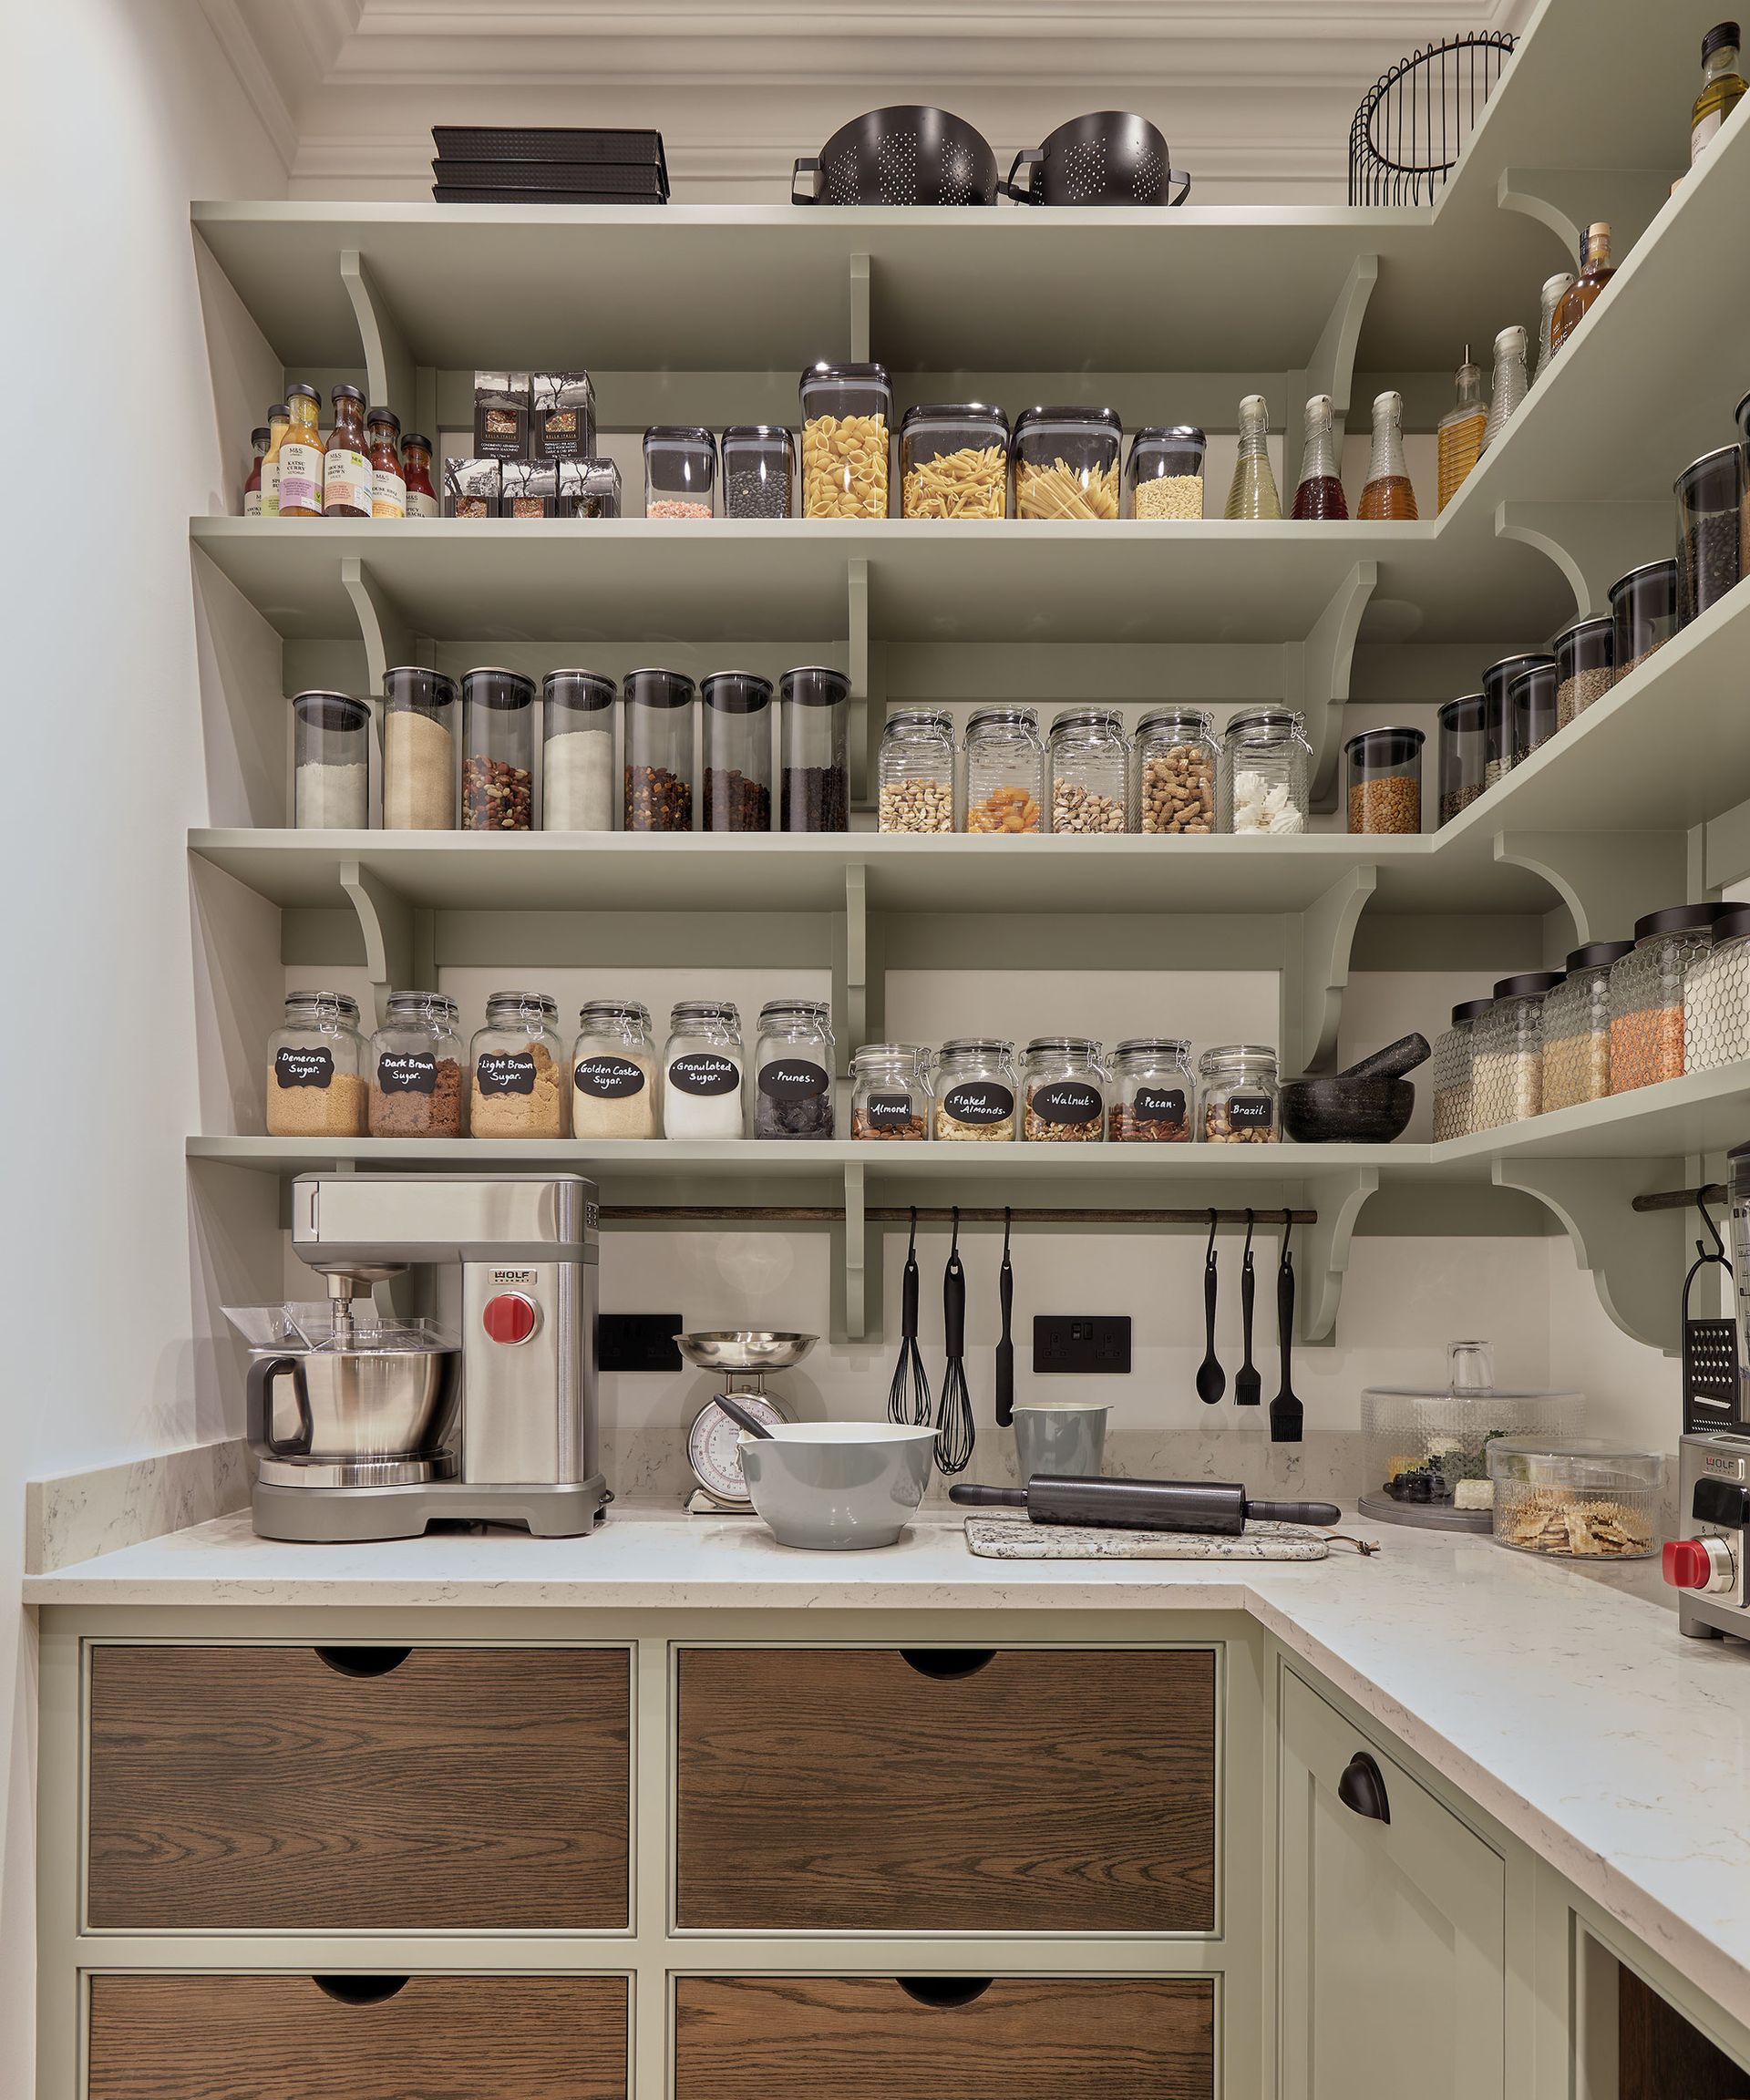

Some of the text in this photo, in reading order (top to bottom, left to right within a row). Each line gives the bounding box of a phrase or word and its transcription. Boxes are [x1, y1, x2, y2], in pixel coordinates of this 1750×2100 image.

[282, 1052, 326, 1064] Demerara
[385, 1058, 434, 1070] Dark Brown
[481, 1059, 533, 1074] Light Brown
[580, 1063, 640, 1076] Golden Caster
[676, 1060, 732, 1072] Granulated
[953, 1095, 986, 1106] Flaked
[494, 1271, 530, 1279] WOLF
[1705, 1457, 1735, 1469] WOLF
